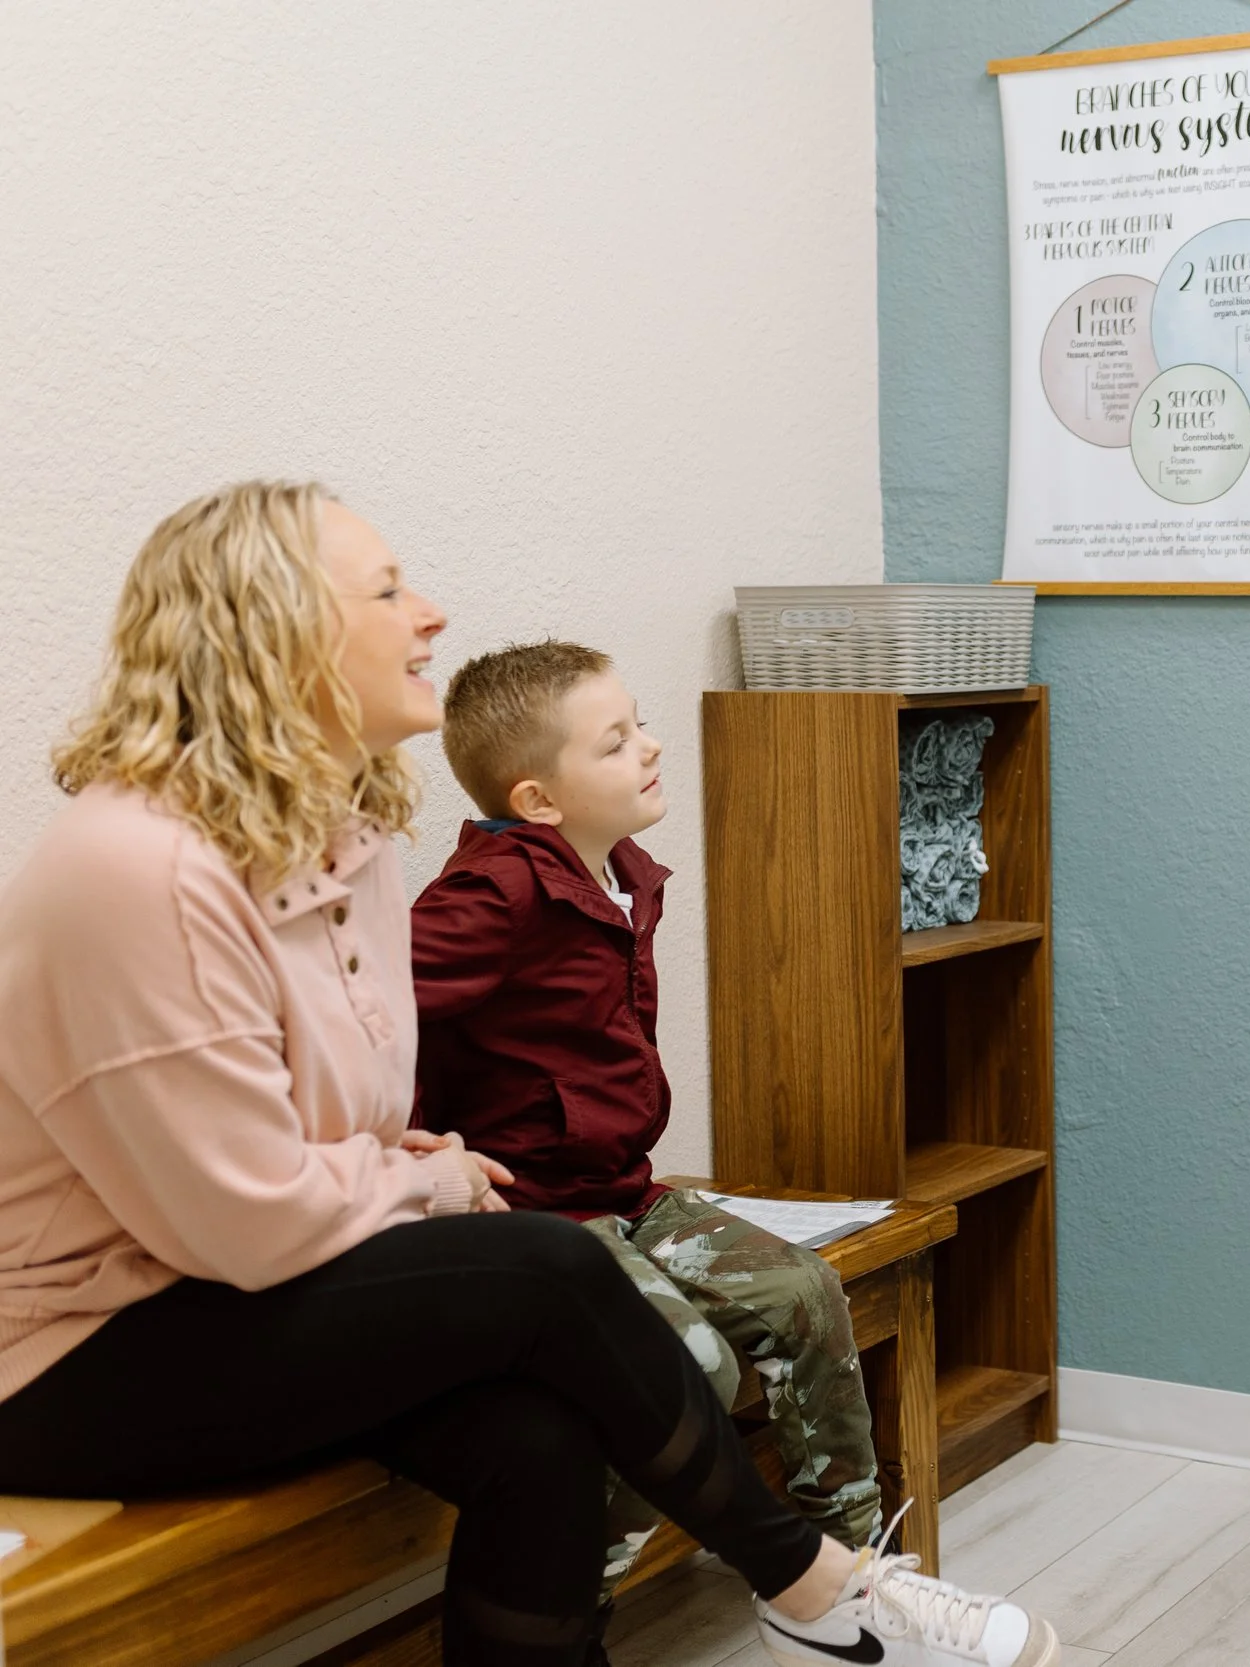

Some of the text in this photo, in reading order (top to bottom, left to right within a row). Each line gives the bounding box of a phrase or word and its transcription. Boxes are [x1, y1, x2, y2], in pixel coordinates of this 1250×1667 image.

[1076, 77, 1174, 115] BRANCHES
[1182, 74, 1207, 103] OF
[1060, 118, 1167, 154] nervous
[1157, 164, 1199, 181] function
[1024, 212, 1174, 240] 3 PARTS OF THE CENTRAL
[1043, 236, 1156, 261] NERVOUS SYSTEM
[1179, 261, 1195, 292] 2
[1075, 305, 1082, 334] 1
[1091, 296, 1137, 315] MOTOR
[1168, 388, 1226, 408] SENSORY
[1149, 399, 1161, 428] 3
